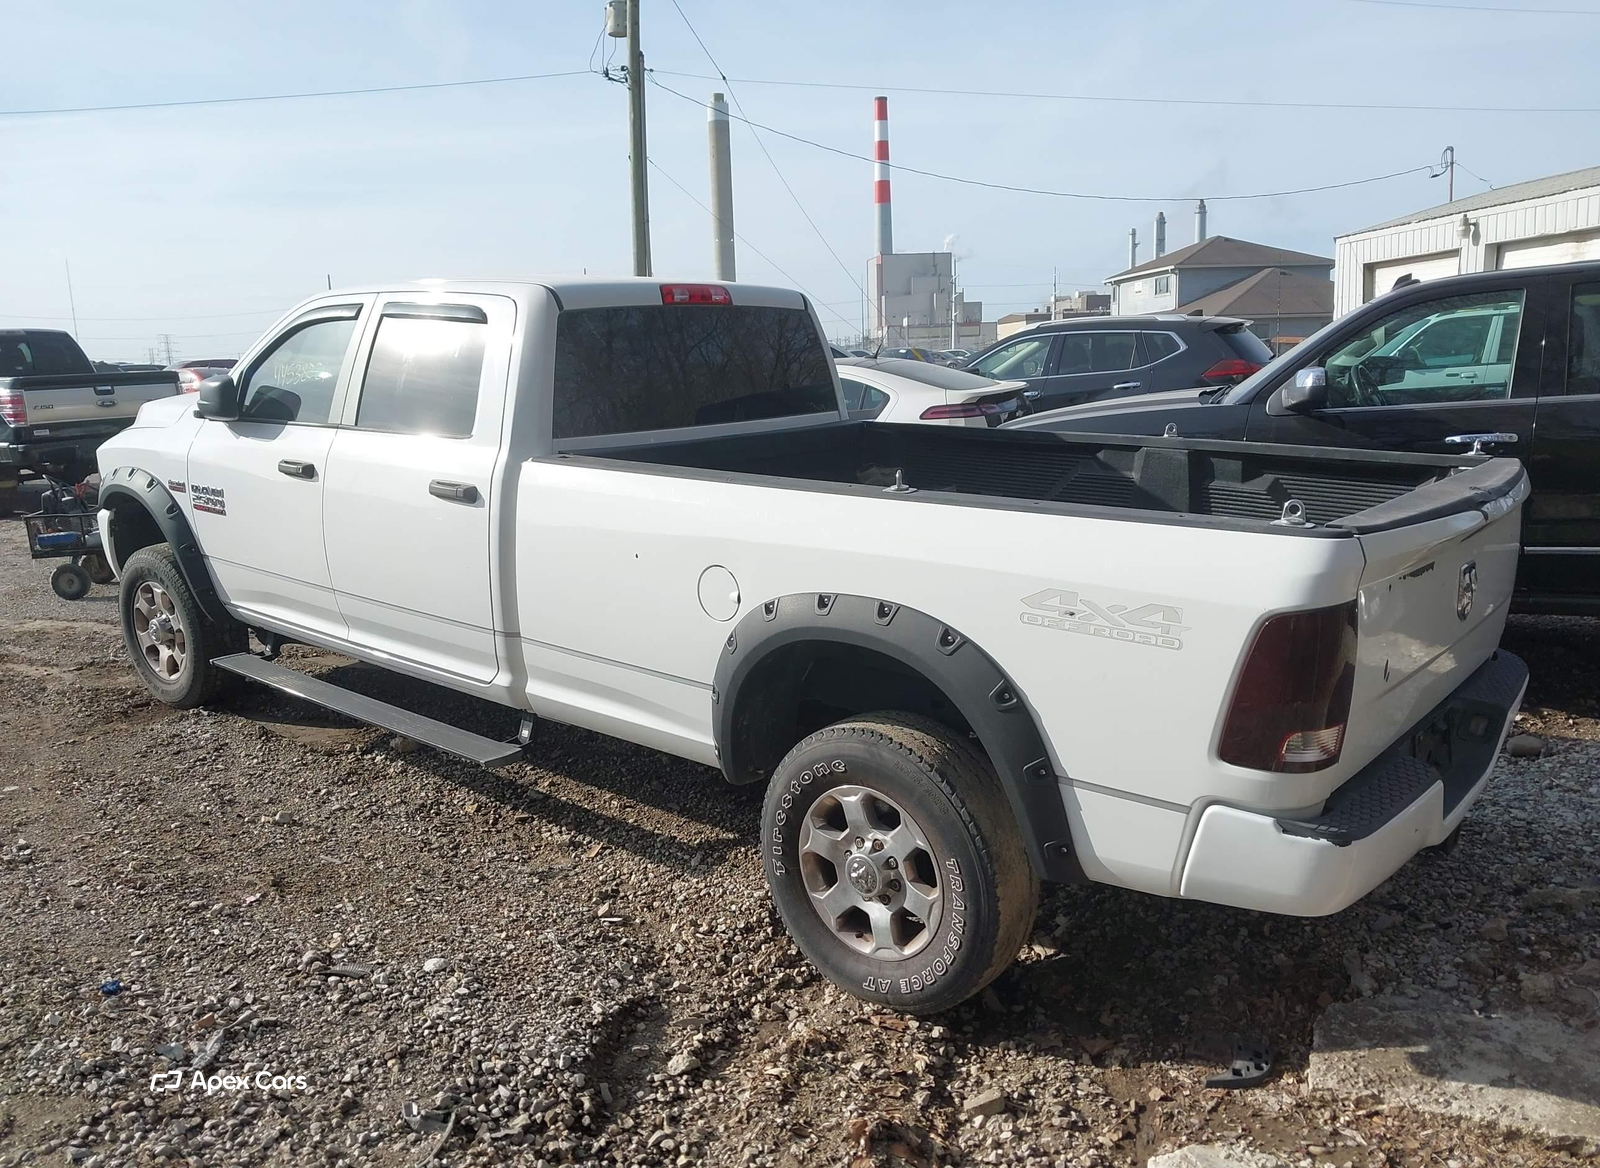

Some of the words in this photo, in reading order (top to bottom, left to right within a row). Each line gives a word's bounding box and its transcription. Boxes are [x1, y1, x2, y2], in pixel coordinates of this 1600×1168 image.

[1022, 612, 1084, 632] OFF
[1088, 624, 1181, 649] ROAD
[899, 858, 965, 993] TRANSFORCE
[862, 976, 892, 993] AT
